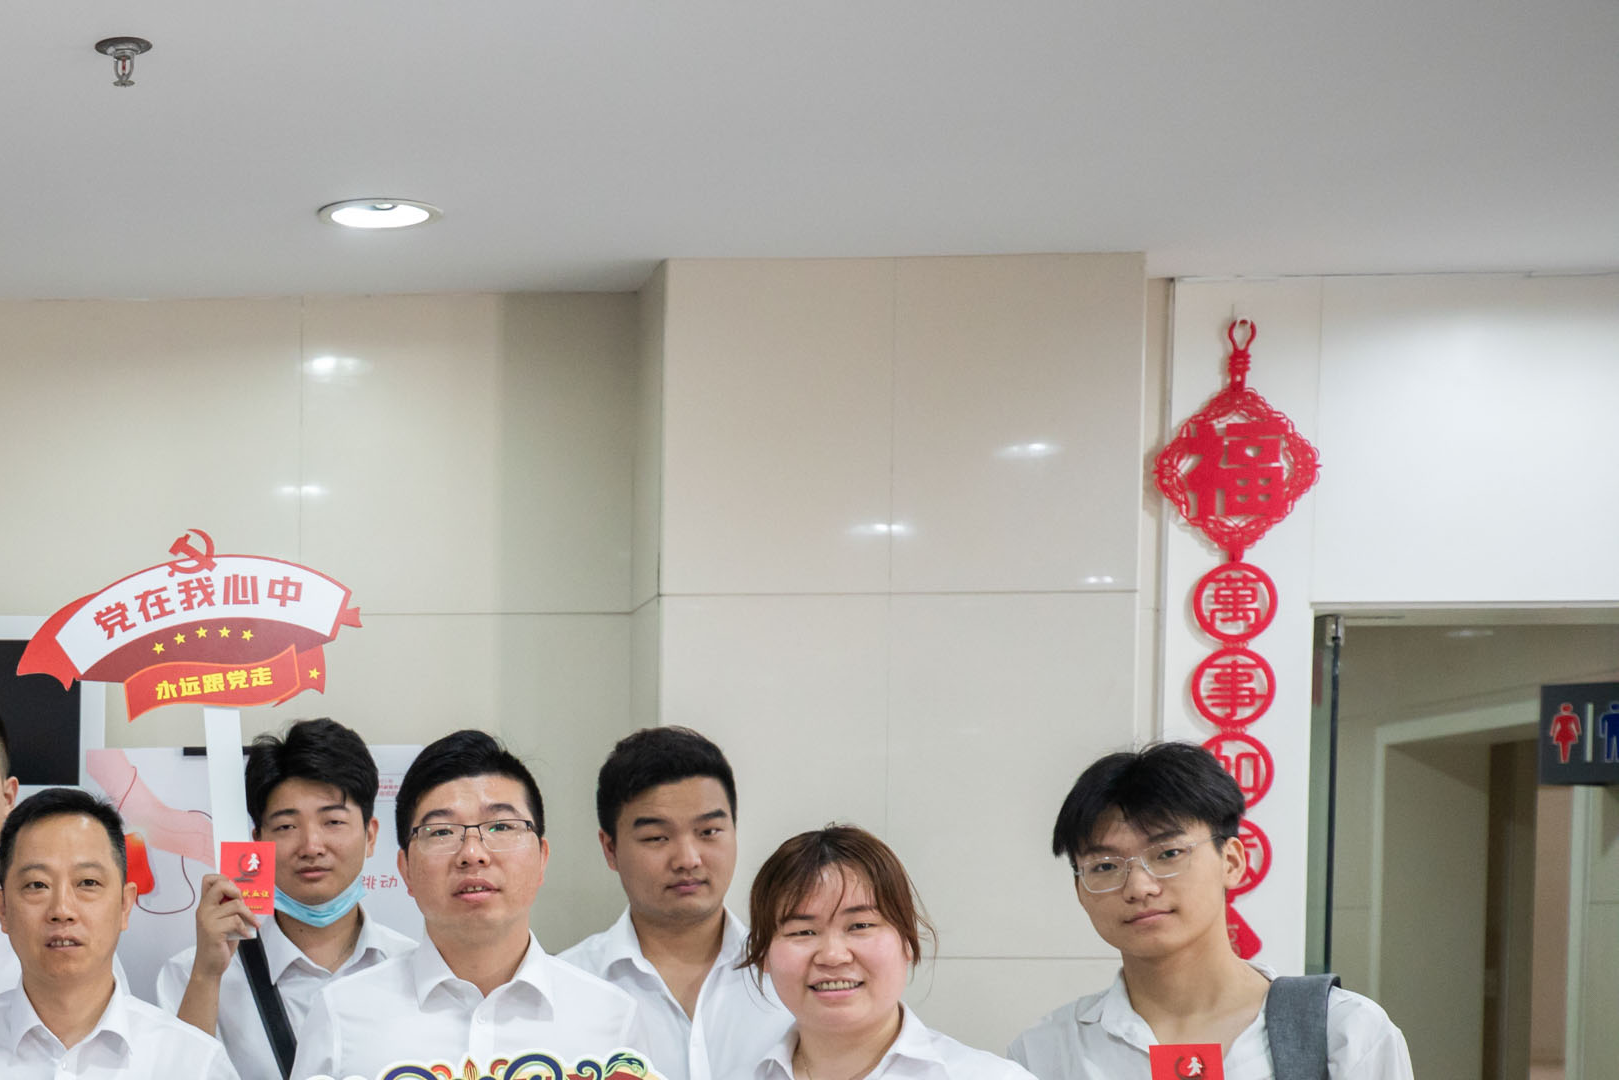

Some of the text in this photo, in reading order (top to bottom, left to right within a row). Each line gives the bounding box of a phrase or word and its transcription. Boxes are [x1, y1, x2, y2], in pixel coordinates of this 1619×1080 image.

[1182, 420, 1283, 518] 福
[95, 574, 302, 640] 党在我心中
[156, 667, 273, 700] 永远跟党走
